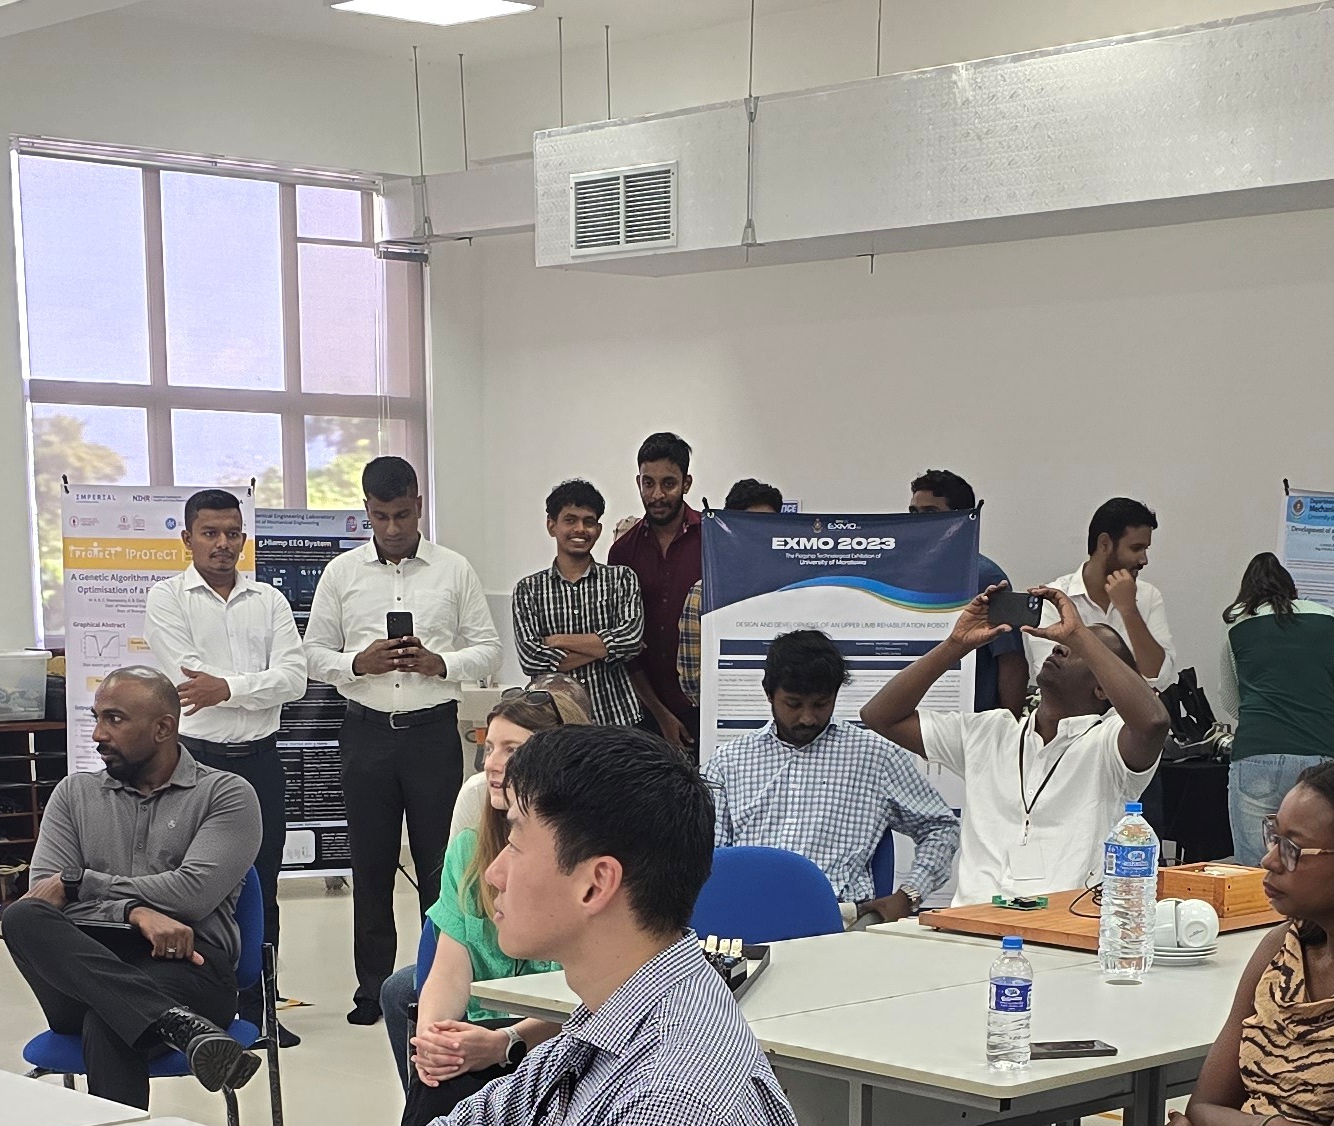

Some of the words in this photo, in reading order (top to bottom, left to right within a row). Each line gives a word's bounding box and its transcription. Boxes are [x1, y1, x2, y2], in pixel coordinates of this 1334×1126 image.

[1291, 525, 1325, 535] Development
[304, 539, 332, 549] System
[772, 537, 835, 550] EXMO
[837, 537, 896, 550] 2023
[71, 573, 78, 581] A
[78, 573, 110, 581] Genetic
[110, 573, 149, 583] Algorithm
[77, 585, 129, 595] Optimisation
[129, 586, 138, 594] of
[773, 621, 819, 629] DEVELOPMENT
[840, 621, 860, 629] UPPER
[861, 621, 875, 629] LIMB
[876, 621, 926, 629] REHABILITATION
